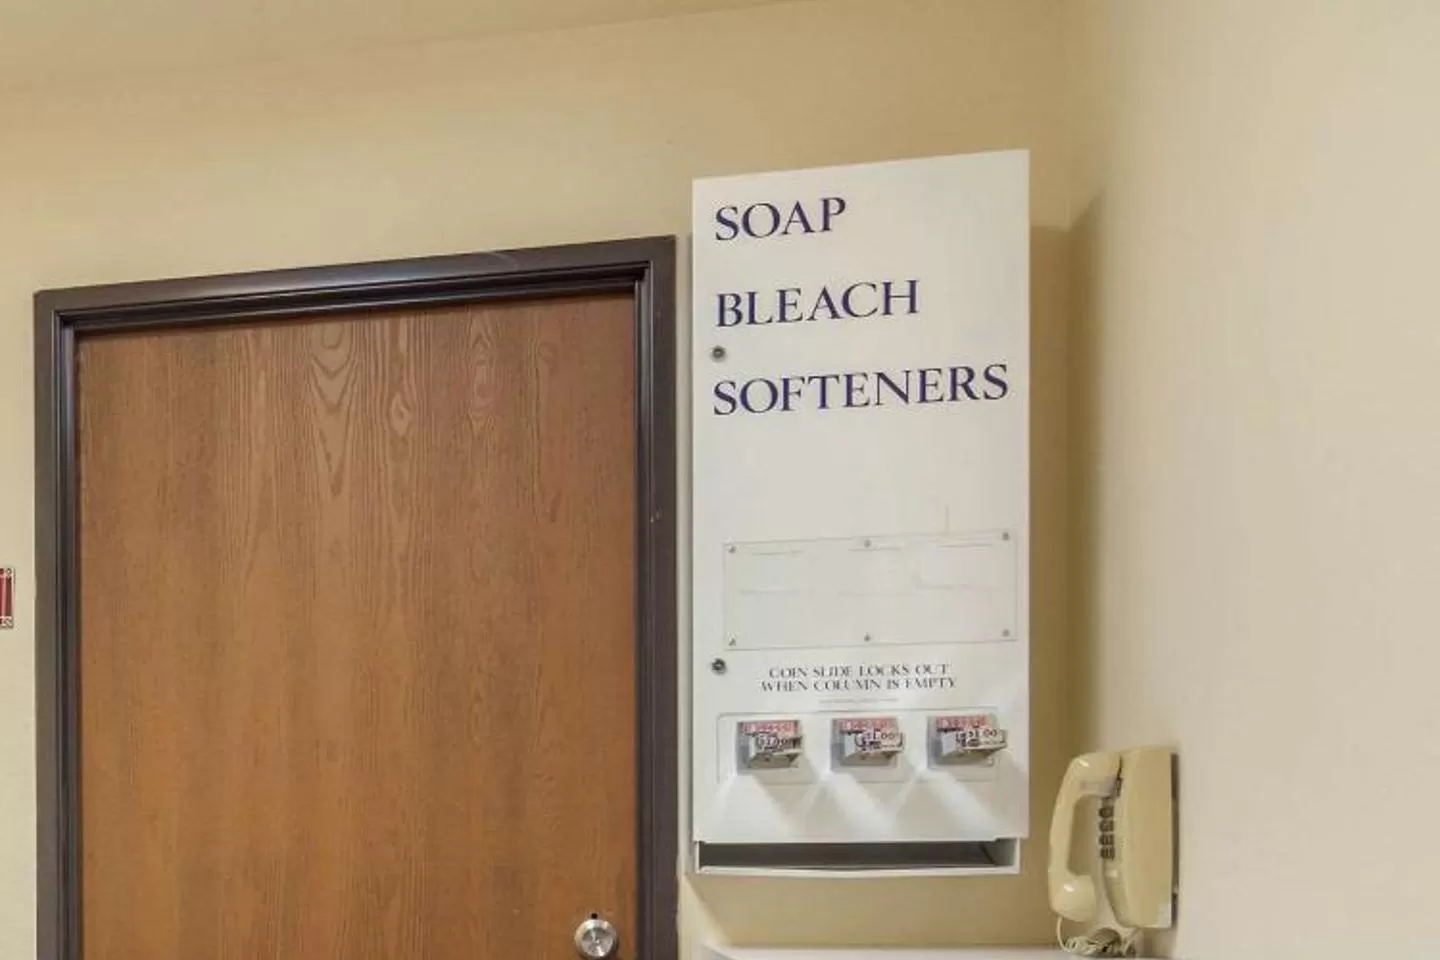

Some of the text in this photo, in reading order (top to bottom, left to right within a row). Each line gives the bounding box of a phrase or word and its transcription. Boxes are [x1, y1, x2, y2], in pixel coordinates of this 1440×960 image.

[714, 196, 847, 242] SOAP
[716, 279, 921, 328] BLEACH
[713, 363, 1009, 416] SOFTENERS
[760, 677, 958, 692] WHEN COLUMN IS EMPTY
[768, 663, 951, 679] COIN SLIDE LOCKS OUT
